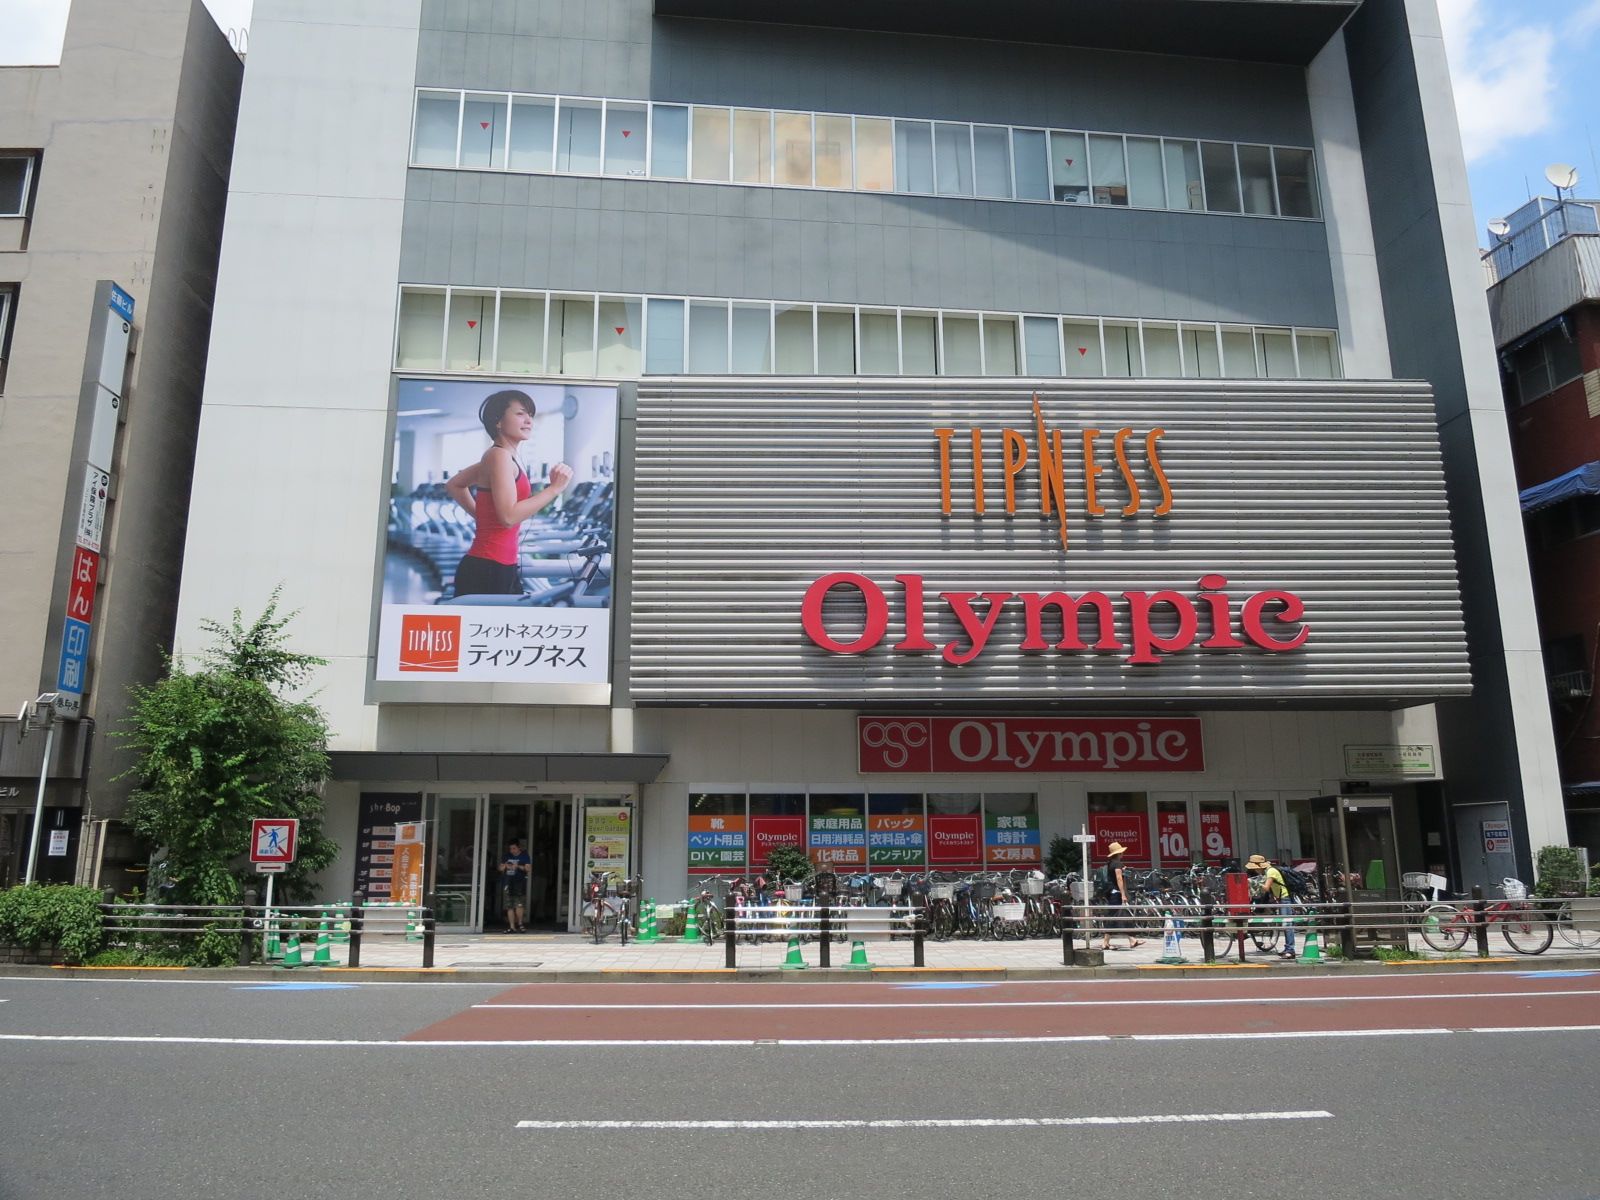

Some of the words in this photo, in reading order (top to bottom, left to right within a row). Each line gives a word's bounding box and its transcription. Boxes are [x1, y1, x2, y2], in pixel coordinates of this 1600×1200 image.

[934, 390, 1173, 551] TIPNESS
[73, 552, 94, 616] はん
[801, 572, 1310, 666] Olympic
[469, 623, 588, 640] フィットネスクラブ
[408, 622, 453, 660] TIPNESS
[63, 625, 85, 689] 印刷
[467, 644, 587, 668] ティップネス
[949, 721, 1189, 769] Olympic
[710, 818, 725, 830] 靴
[813, 818, 863, 830] 家庭用品
[877, 817, 916, 829] バッグ
[997, 816, 1028, 829] 家電
[690, 834, 744, 846] ペット用品
[756, 832, 798, 842] Olympic
[811, 833, 865, 846] 日用消耗品
[870, 833, 922, 846] 衣料品・傘
[934, 831, 974, 841] Olympic
[997, 831, 1028, 844] 時計
[1100, 829, 1138, 839] Olympic
[691, 851, 745, 862] DIY・園芸
[817, 850, 859, 862] 化粧品
[870, 849, 922, 861] インテリア
[992, 848, 1036, 860] 文房具
